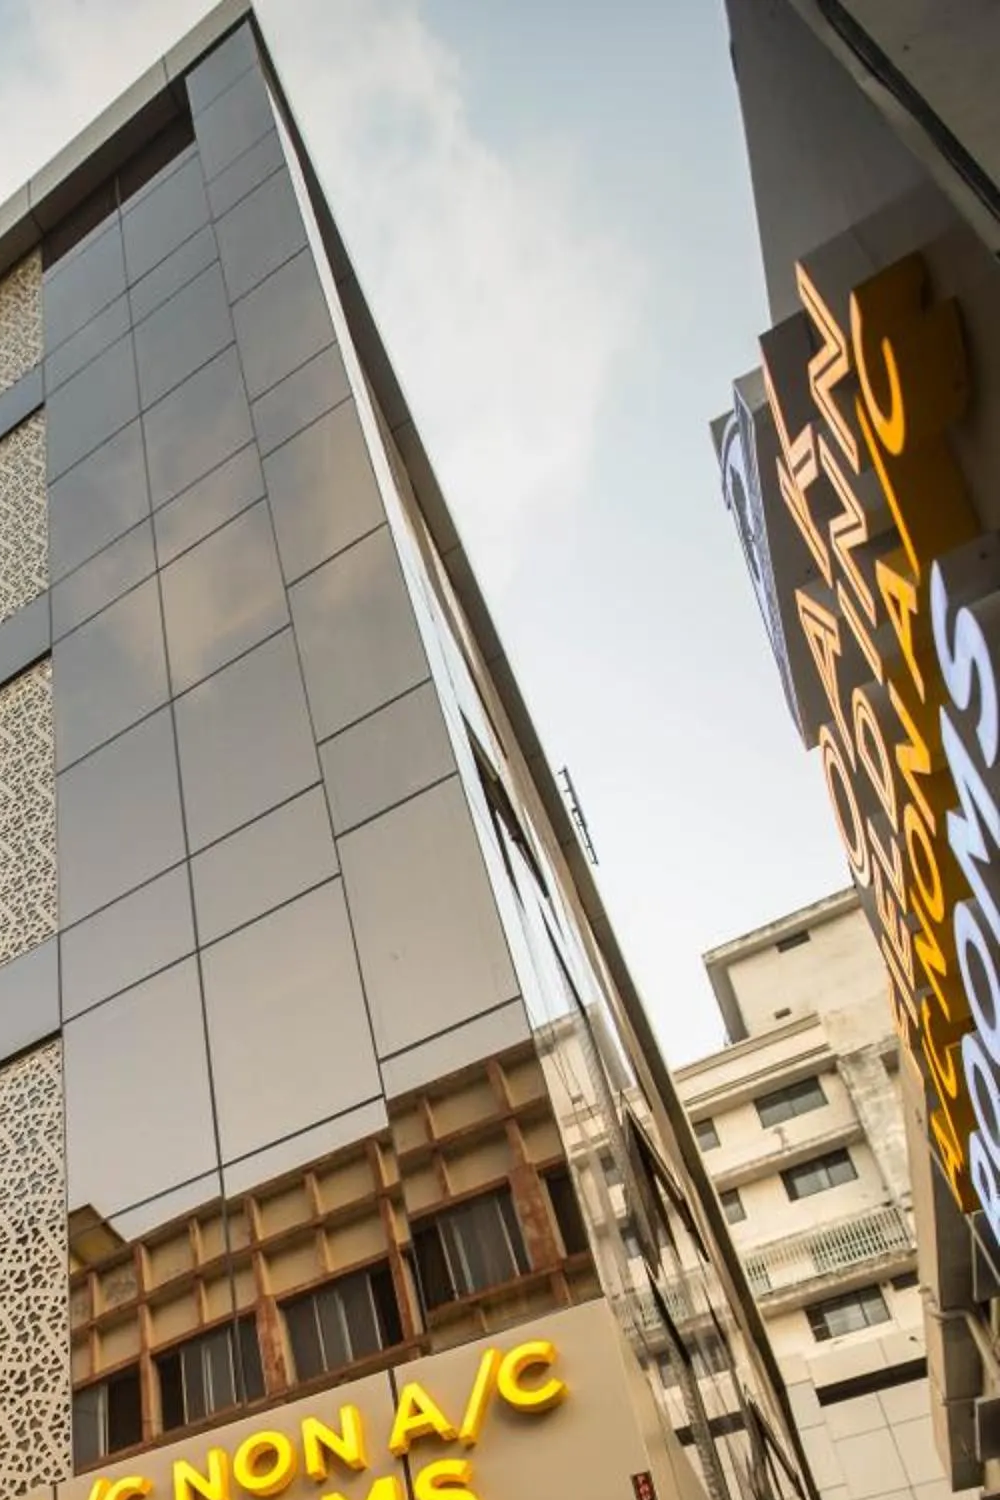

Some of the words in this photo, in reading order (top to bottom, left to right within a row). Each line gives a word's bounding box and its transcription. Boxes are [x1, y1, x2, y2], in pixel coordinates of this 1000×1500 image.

[758, 338, 870, 888] OAK
[796, 259, 884, 686] INN
[850, 289, 925, 704] A/C
[888, 678, 950, 1022] NON
[930, 559, 1000, 1247] ROOMS
[388, 1339, 570, 1457] A/C
